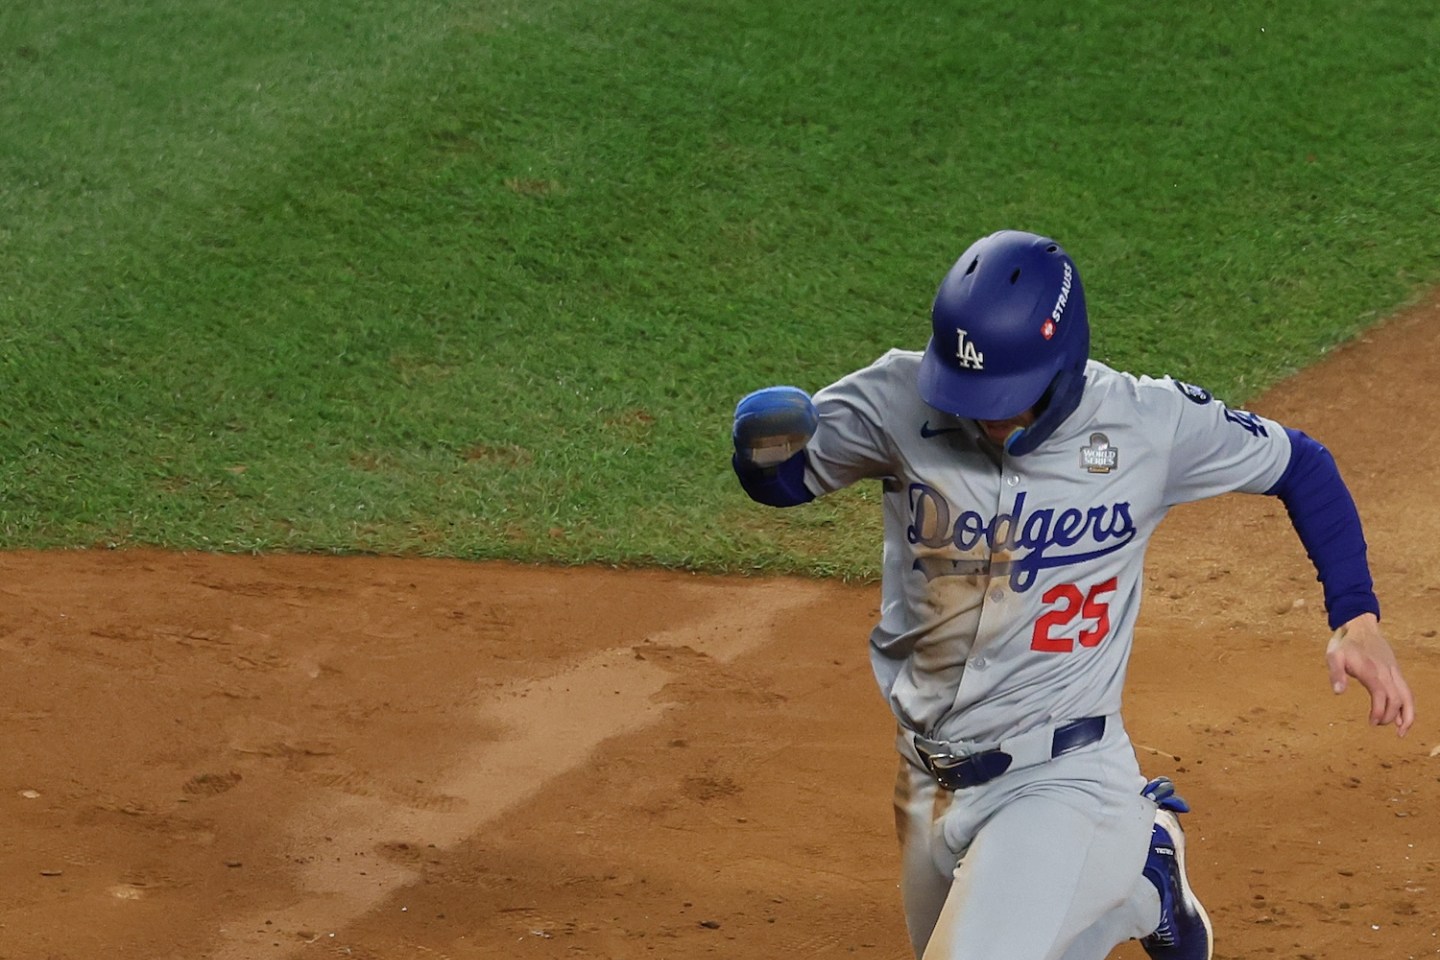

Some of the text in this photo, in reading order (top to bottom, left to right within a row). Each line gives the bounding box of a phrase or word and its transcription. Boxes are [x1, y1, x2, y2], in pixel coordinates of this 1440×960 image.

[1052, 263, 1073, 322] STRAUSS
[956, 329, 984, 370] LA
[1083, 449, 1116, 459] WORLD
[908, 484, 1137, 592] Dodgers
[1031, 577, 1117, 653] 25
